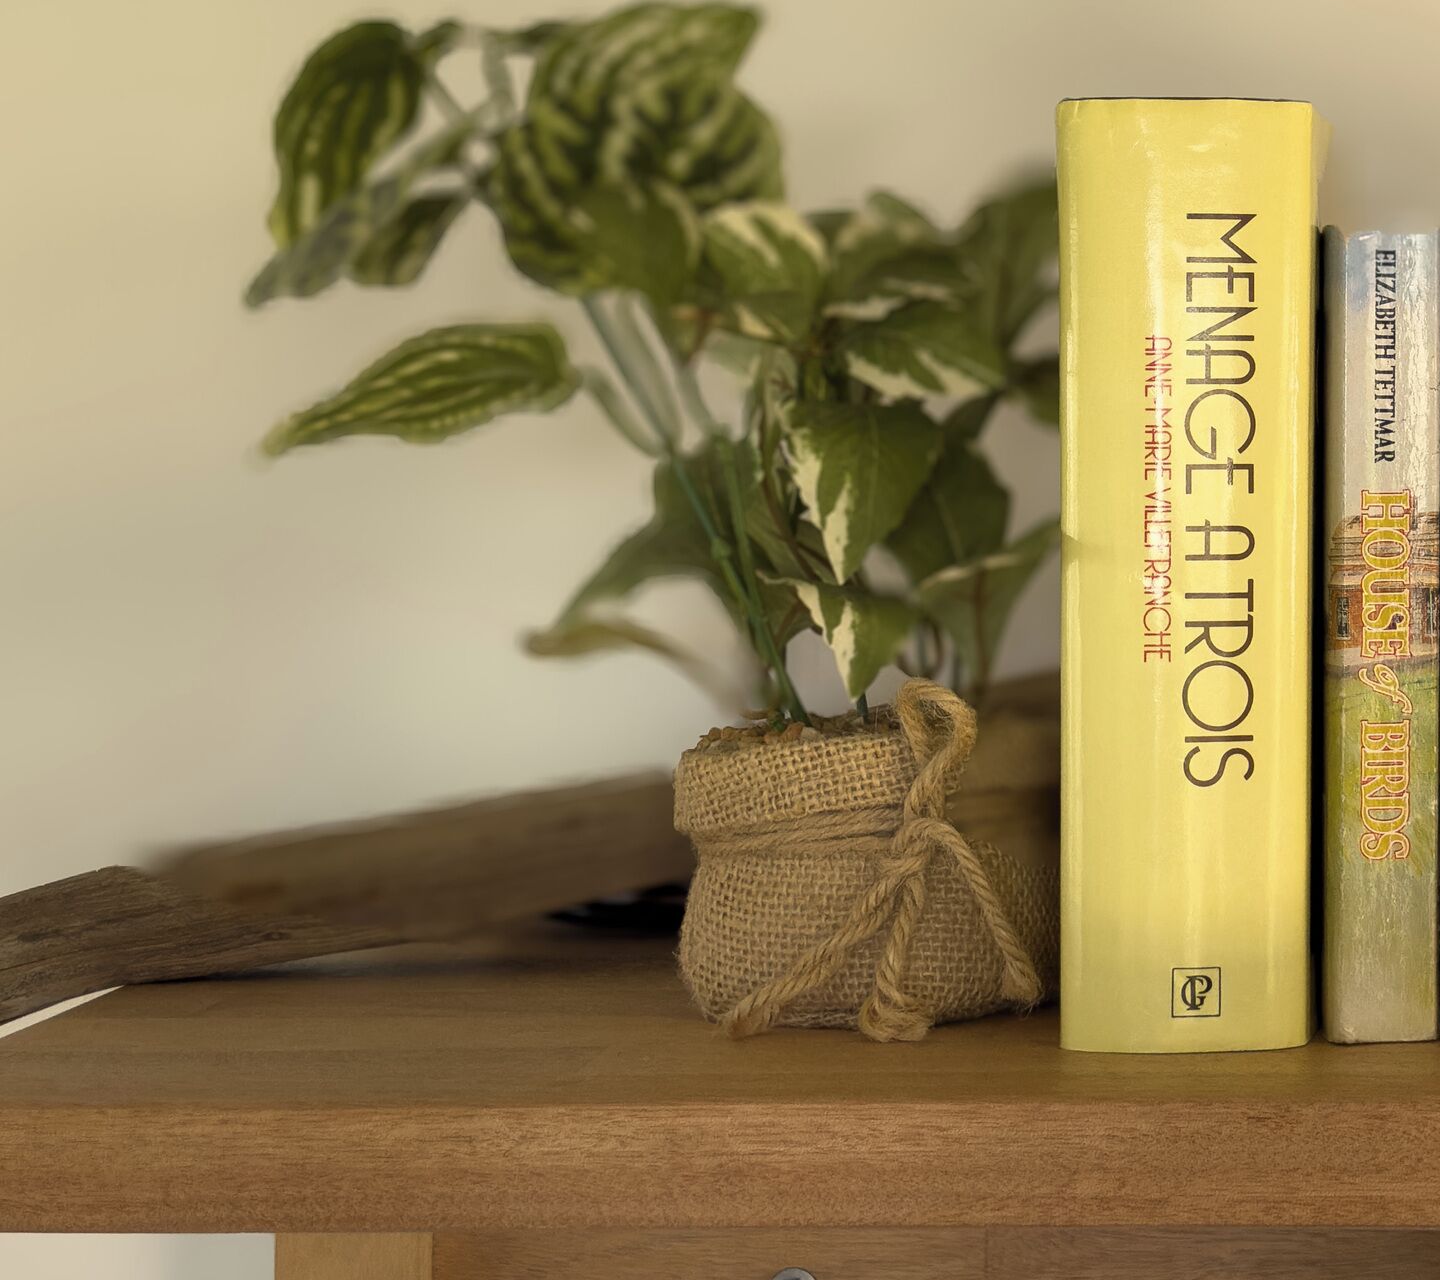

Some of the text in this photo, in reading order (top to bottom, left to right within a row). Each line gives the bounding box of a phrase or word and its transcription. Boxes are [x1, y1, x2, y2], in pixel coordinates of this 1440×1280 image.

[1143, 335, 1173, 663] ANNE-MARIE VILLEFRANCHE
[1182, 213, 1259, 787] MENAGE A TROIS
[1374, 249, 1397, 463] ELIZABETH TETTMAR
[1358, 489, 1414, 861] HOUSE of BIRDS
